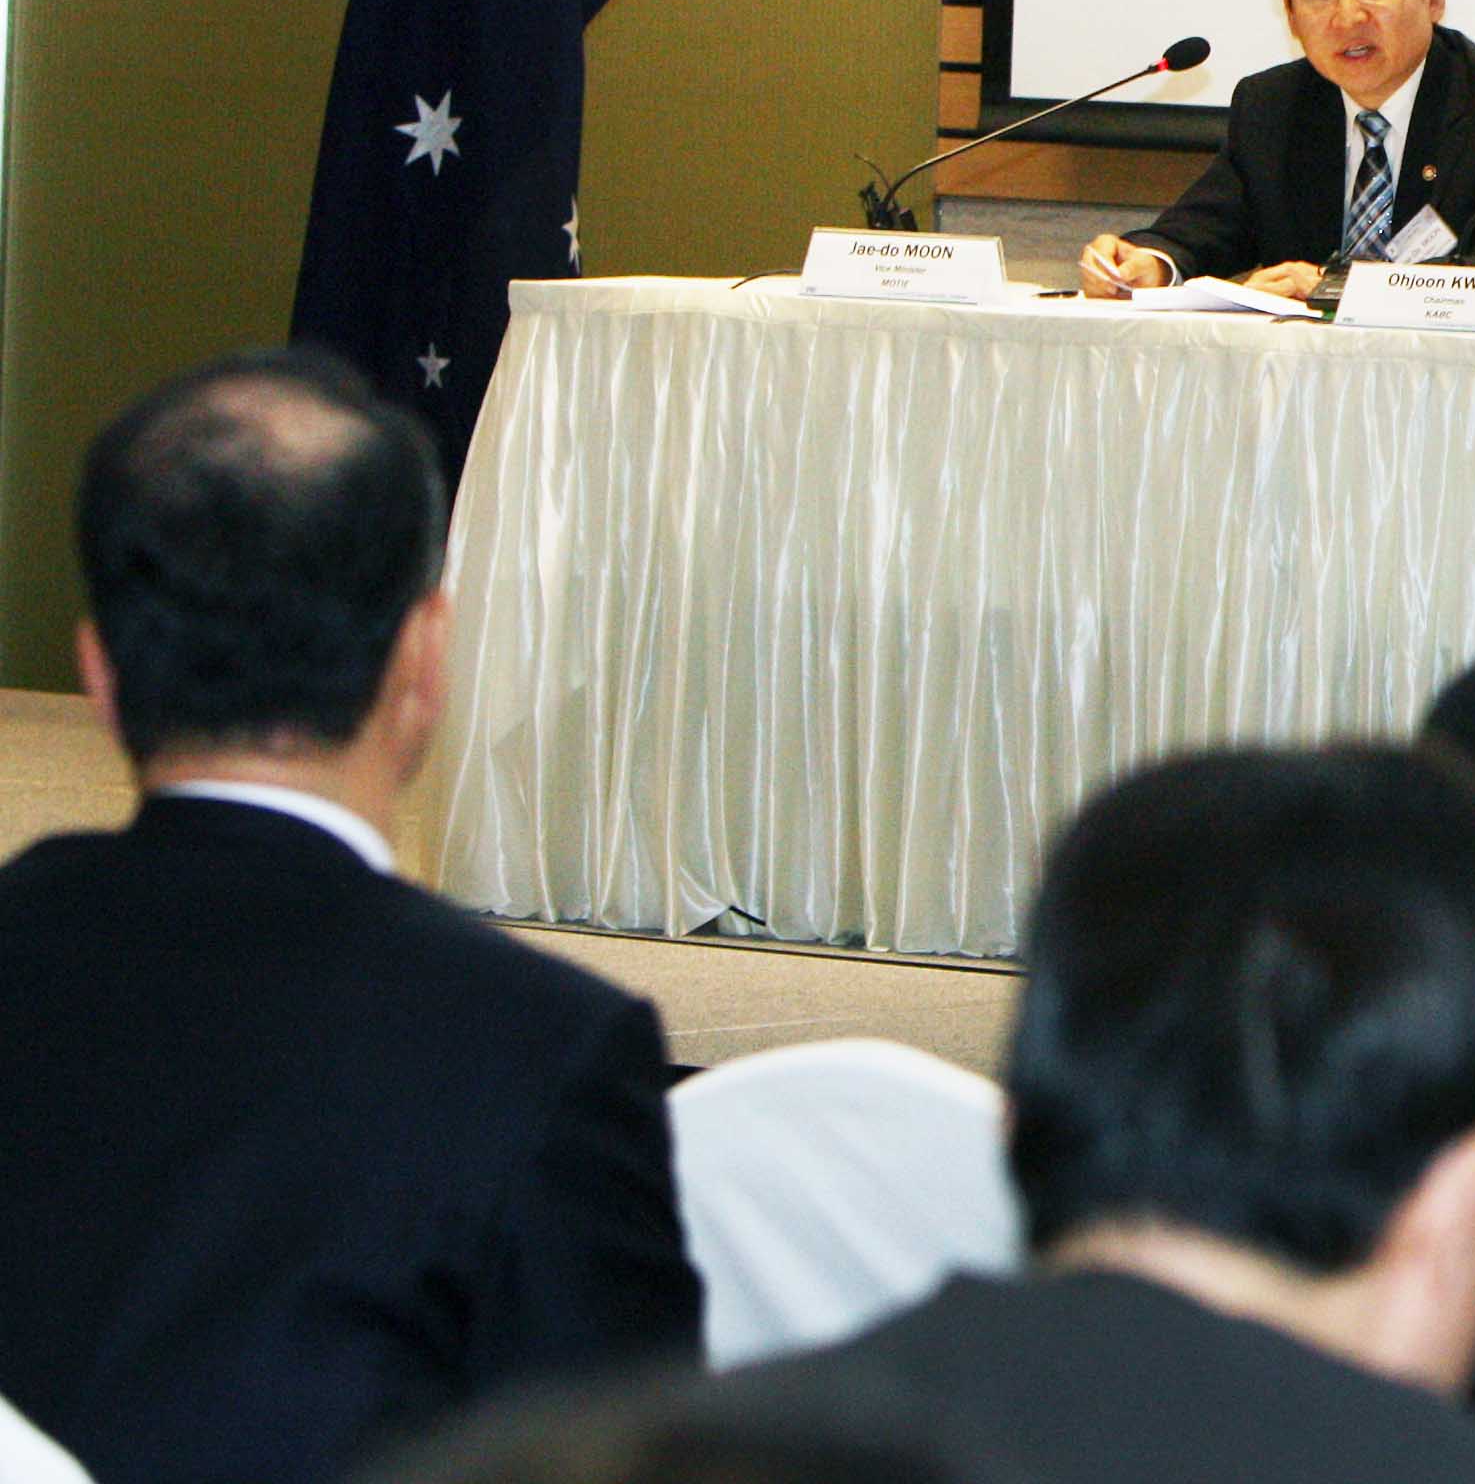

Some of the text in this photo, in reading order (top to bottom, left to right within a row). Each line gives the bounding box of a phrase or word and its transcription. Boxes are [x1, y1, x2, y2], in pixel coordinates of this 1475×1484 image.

[849, 241, 954, 259] Jae-do MOON
[1388, 272, 1445, 290] Ohjoon
